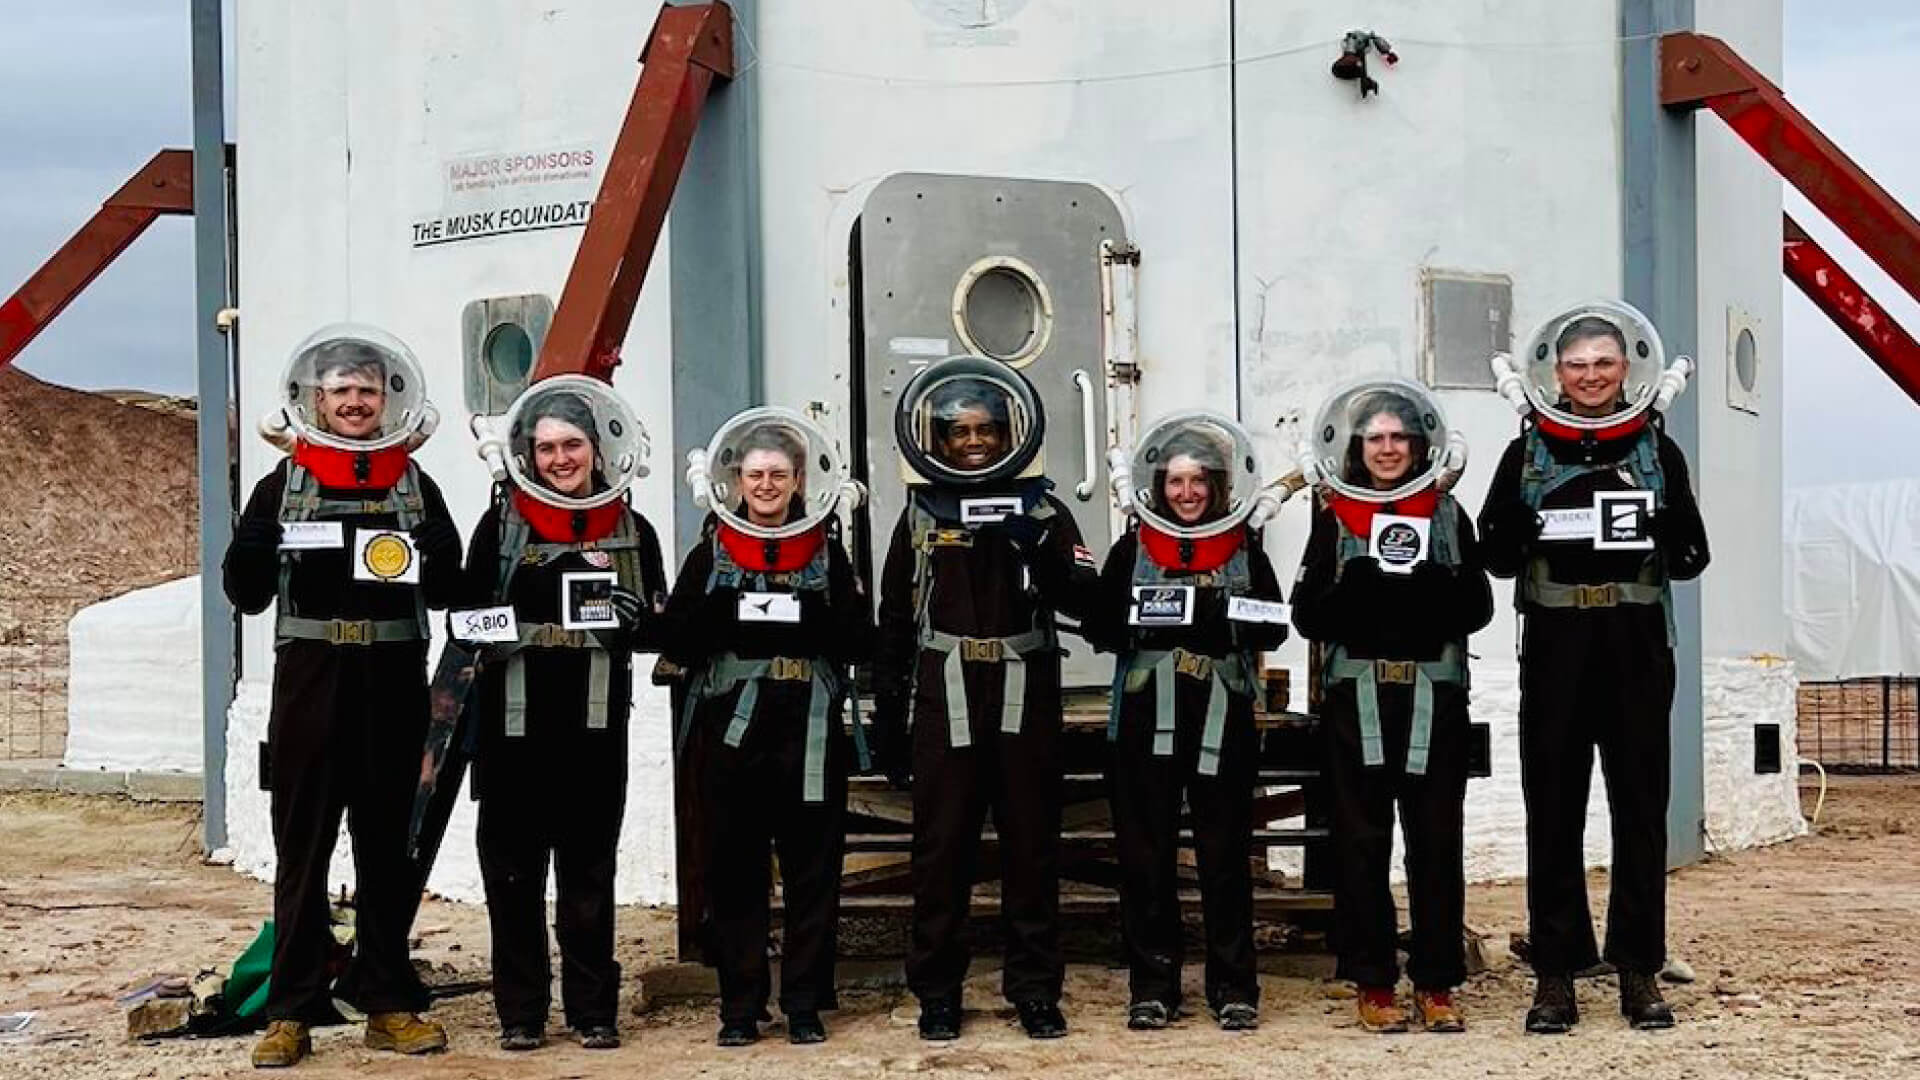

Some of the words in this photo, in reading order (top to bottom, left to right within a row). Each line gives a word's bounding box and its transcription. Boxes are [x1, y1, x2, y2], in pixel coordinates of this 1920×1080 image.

[450, 160, 499, 179] MAJOR
[504, 151, 593, 172] SPONSORS
[413, 221, 442, 240] THE
[446, 212, 495, 236] MUSK
[483, 614, 508, 631] BIO
